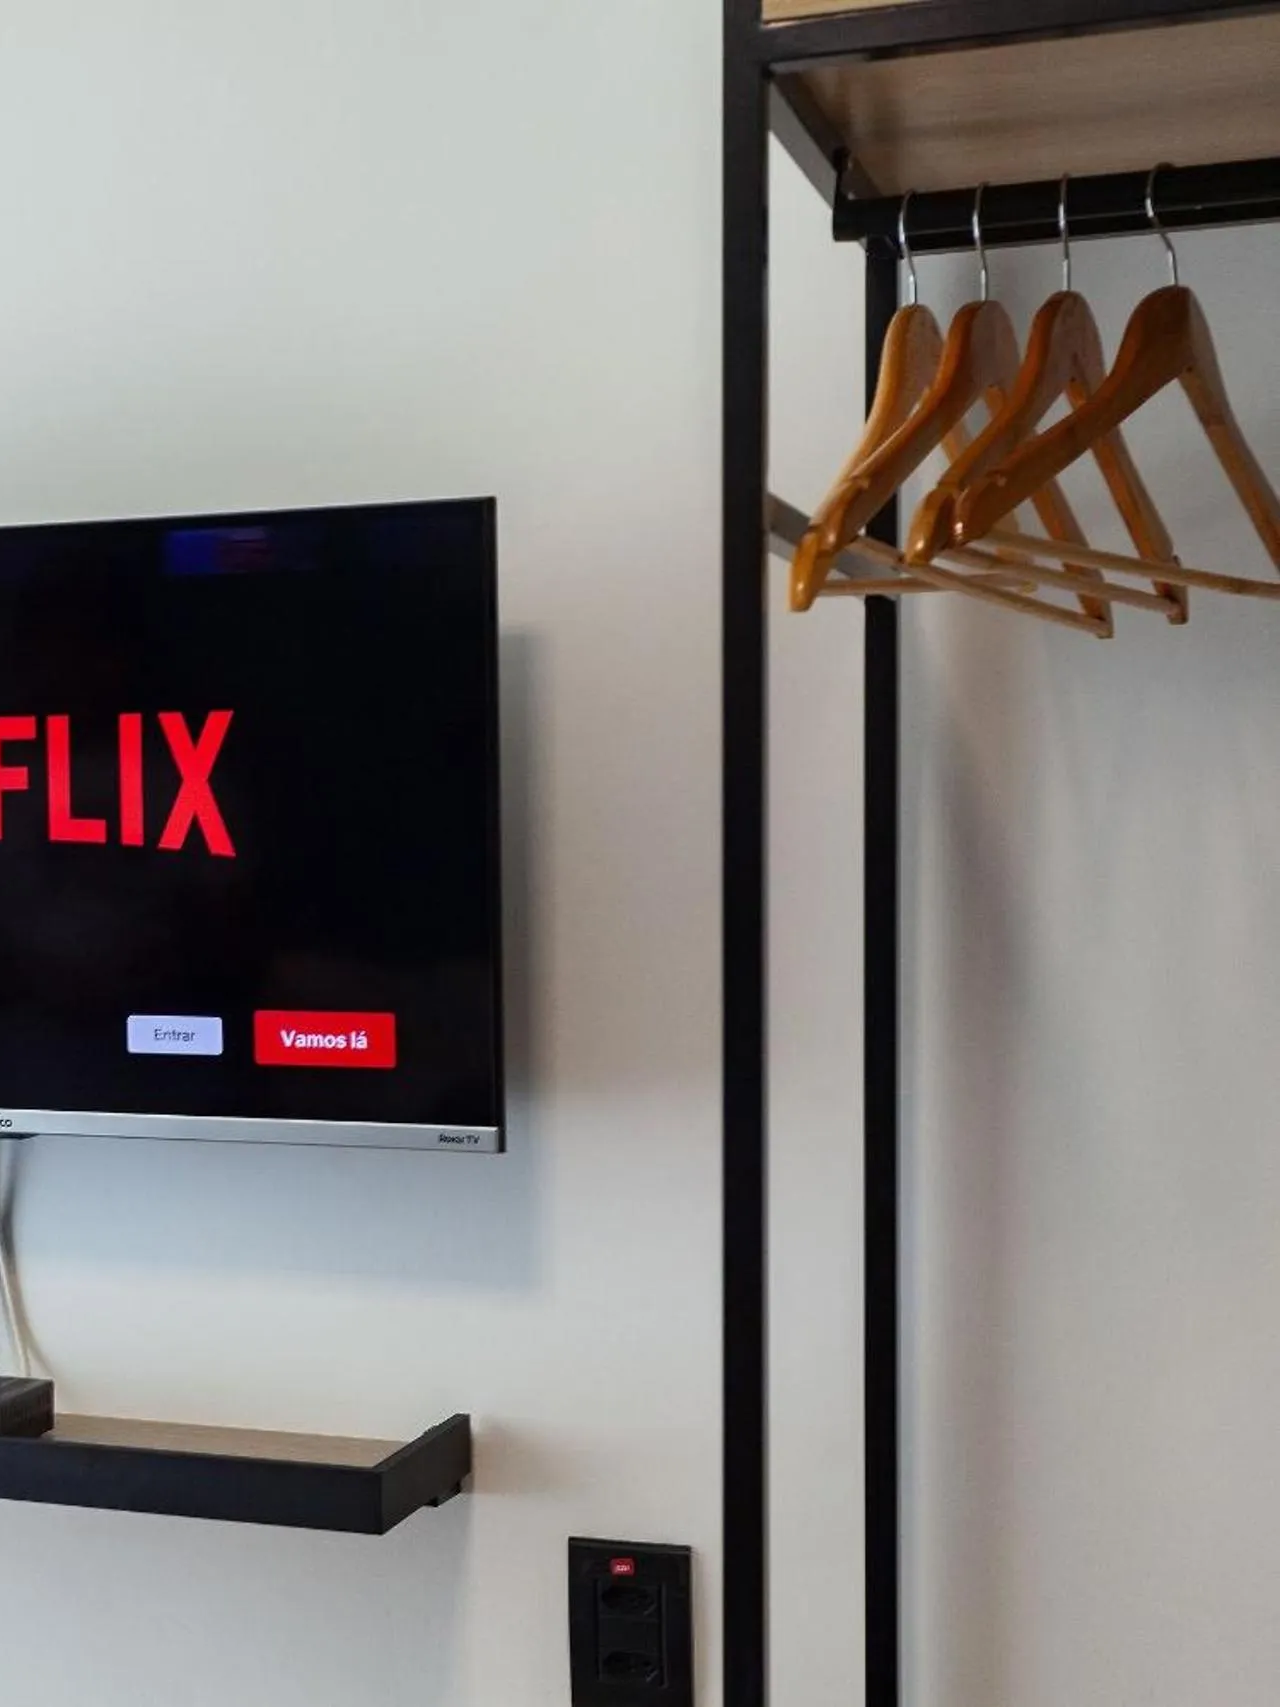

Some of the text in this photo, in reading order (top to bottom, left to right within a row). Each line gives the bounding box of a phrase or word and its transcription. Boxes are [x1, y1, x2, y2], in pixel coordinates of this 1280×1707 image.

[154, 1028, 196, 1042] Entrar
[280, 1029, 368, 1049] Vamos lá
